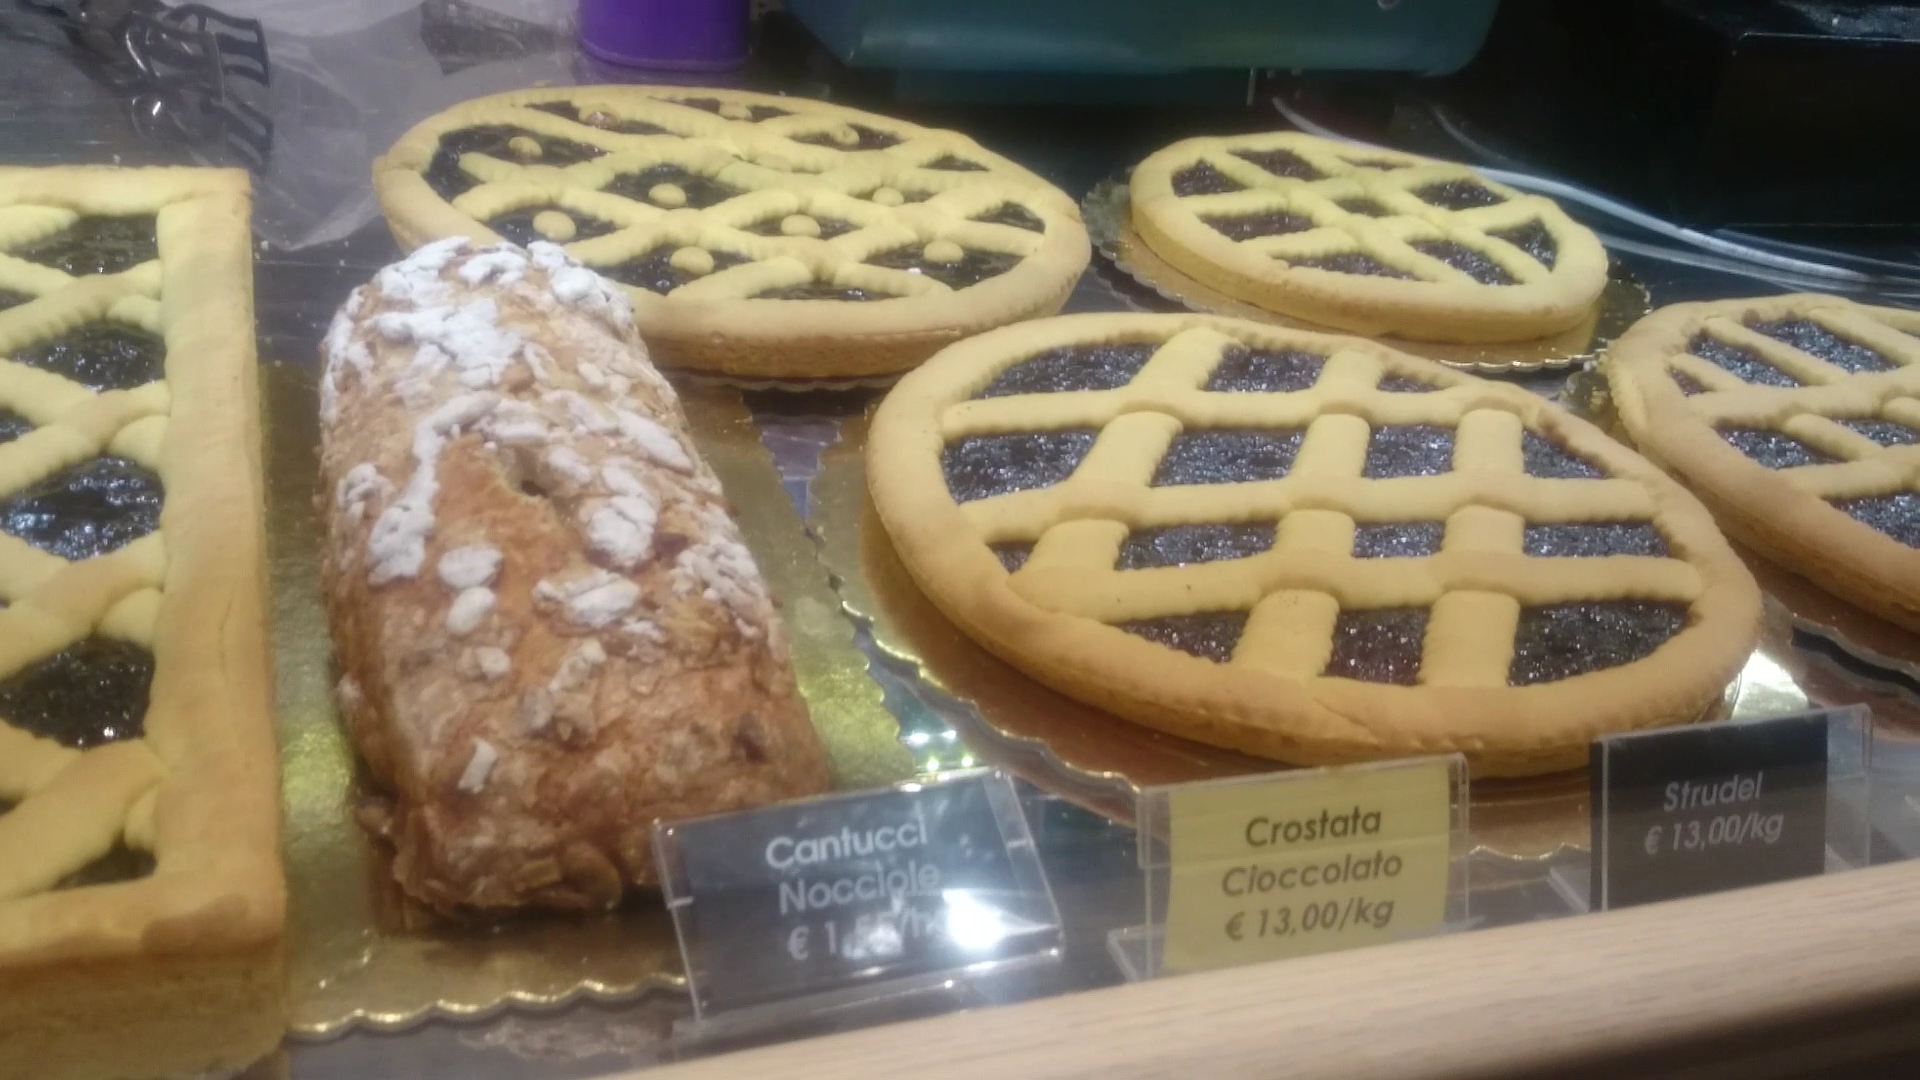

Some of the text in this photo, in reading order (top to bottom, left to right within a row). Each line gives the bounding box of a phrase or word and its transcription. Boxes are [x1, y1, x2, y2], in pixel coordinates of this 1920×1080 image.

[1664, 771, 1763, 812] Strudel
[766, 818, 928, 870] Cantucci
[1245, 806, 1382, 847] Crostata
[1645, 812, 1784, 855] € 13,00/kg
[779, 861, 941, 915] Nocciole
[1222, 850, 1403, 897] Cioccolato
[1226, 897, 1396, 942] € 13,00/kg
[787, 926, 811, 961] €
